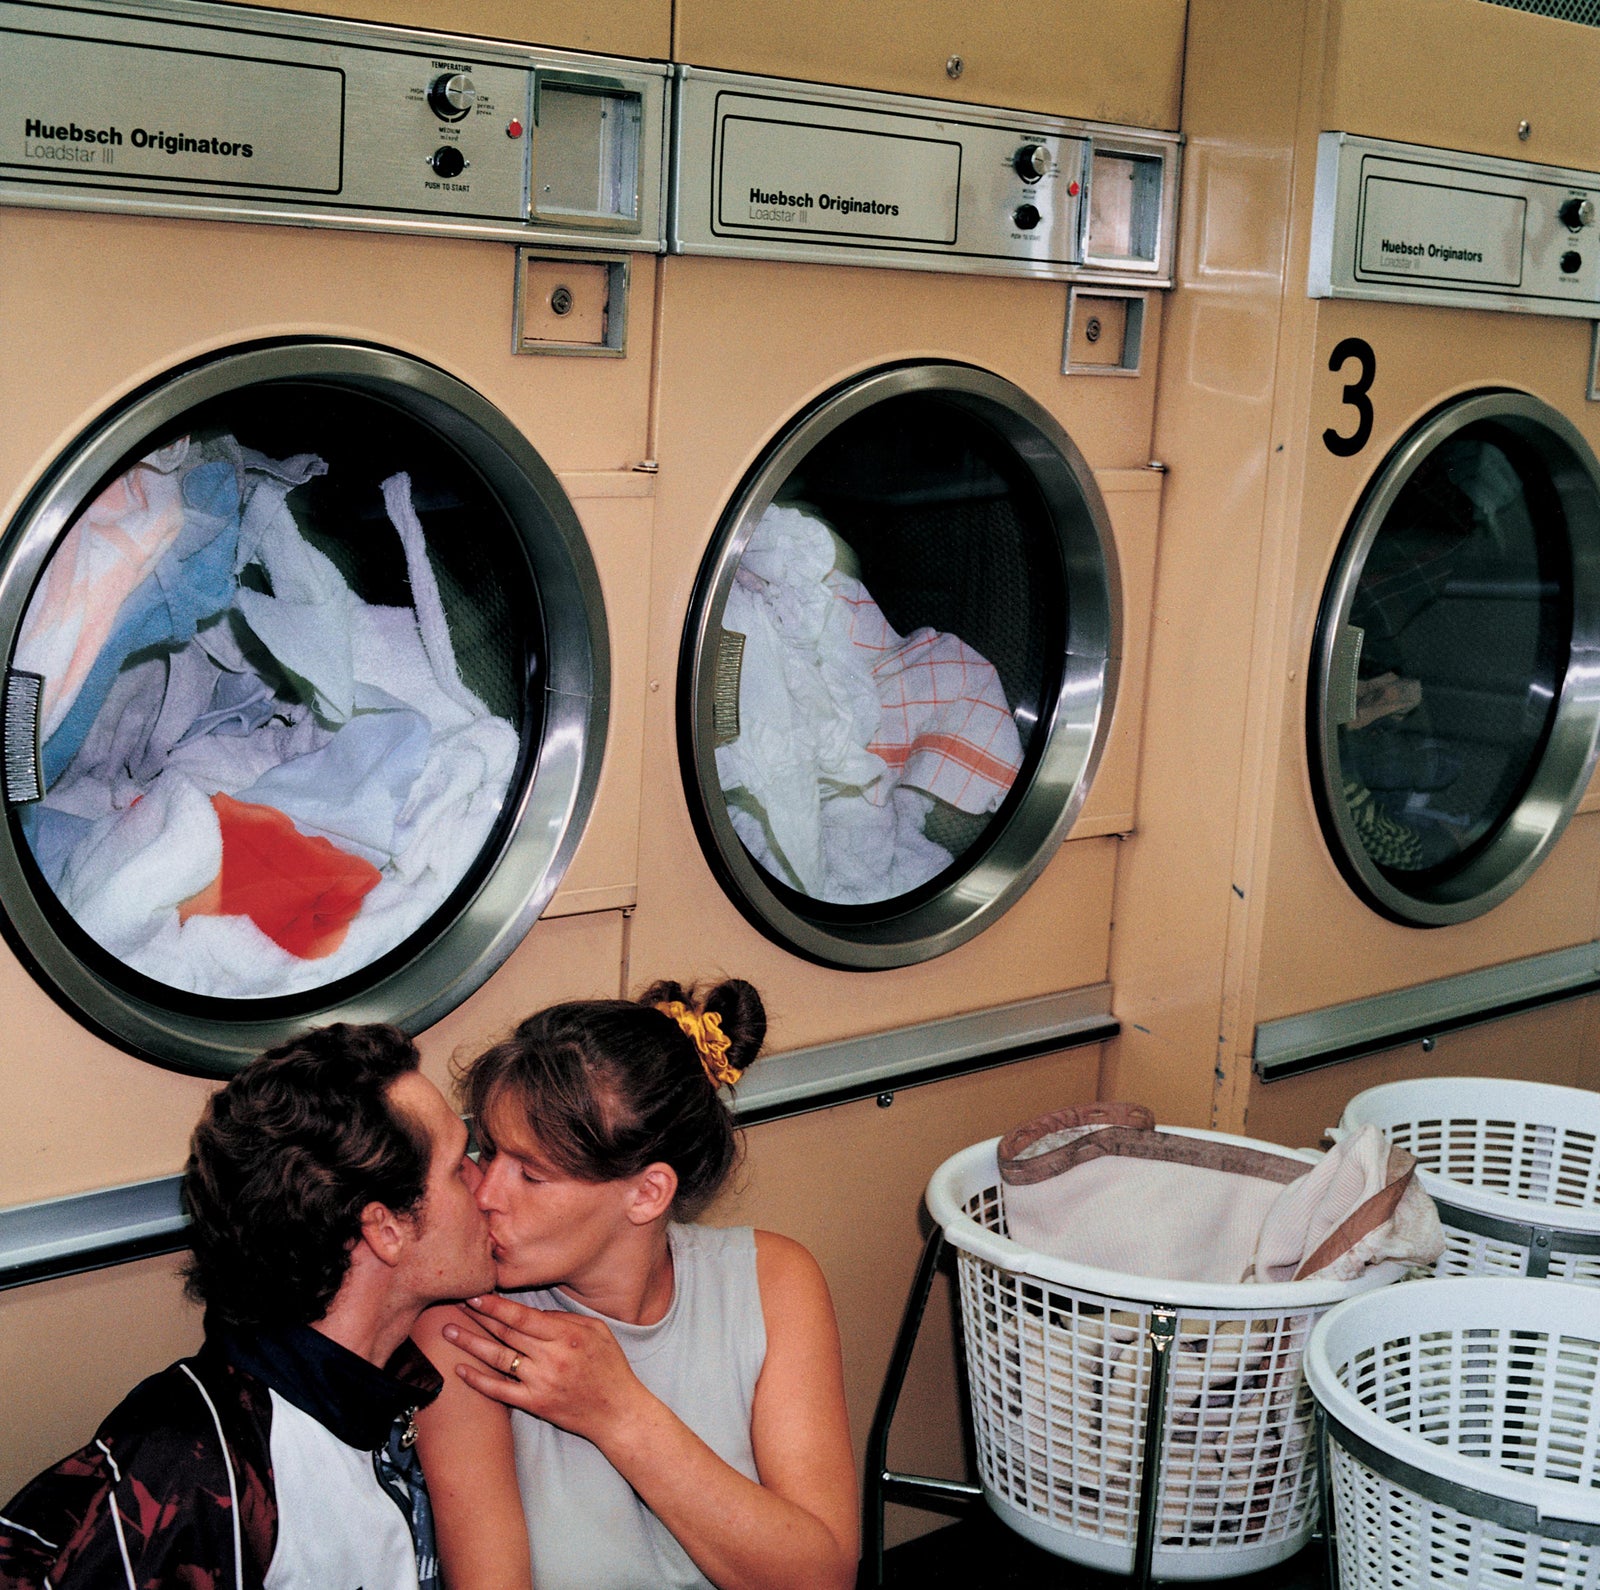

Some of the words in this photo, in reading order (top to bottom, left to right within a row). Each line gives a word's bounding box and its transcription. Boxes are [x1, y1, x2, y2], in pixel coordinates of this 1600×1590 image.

[431, 61, 473, 73] TEMPERATURE
[25, 118, 123, 145] Huebsch
[130, 128, 254, 158] Originators
[24, 141, 95, 163] Loadstar
[102, 148, 114, 164] III
[424, 181, 440, 190] PUSH
[442, 183, 450, 191] TO
[451, 184, 470, 192] START
[749, 188, 814, 208] Huebsch
[818, 194, 899, 216] Originators
[749, 206, 796, 223] Loadstar
[799, 210, 808, 223] III
[1381, 239, 1425, 256] Huebsch
[1428, 244, 1483, 263] Originators
[1322, 337, 1377, 458] 3
